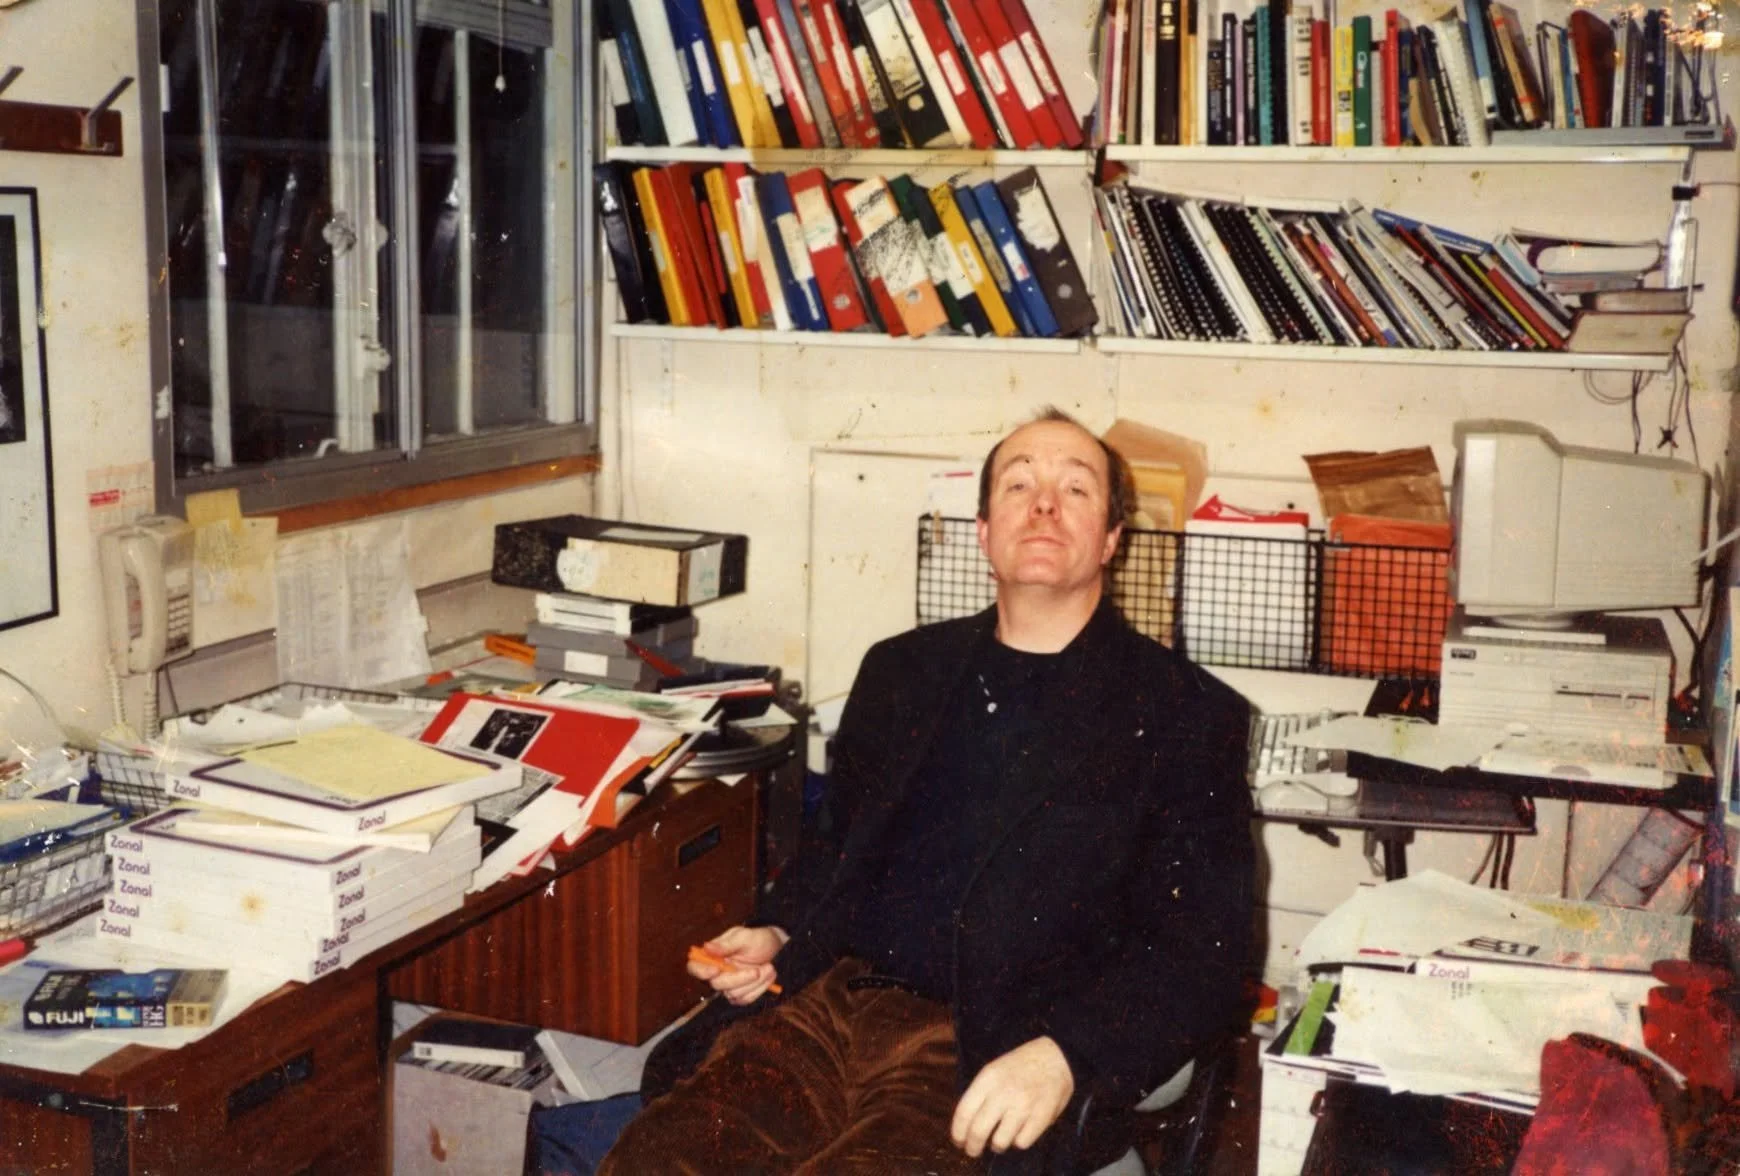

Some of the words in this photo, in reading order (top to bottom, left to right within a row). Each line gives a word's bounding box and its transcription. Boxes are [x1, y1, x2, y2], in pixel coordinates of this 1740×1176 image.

[173, 780, 201, 797] Zonal
[358, 810, 387, 832] Zonal
[110, 834, 143, 852] Zonal
[118, 857, 151, 875] Zonal
[336, 861, 362, 885] Zonal
[120, 879, 153, 897] Zonal
[339, 885, 365, 909] Zonal
[108, 899, 140, 917] Zonal
[100, 919, 132, 937] Zonal
[341, 908, 366, 932] Zonal
[323, 932, 350, 953] Zonal
[314, 950, 341, 975] Zonal
[1428, 963, 1470, 979] Zonal
[46, 1011, 85, 1025] FUJI
